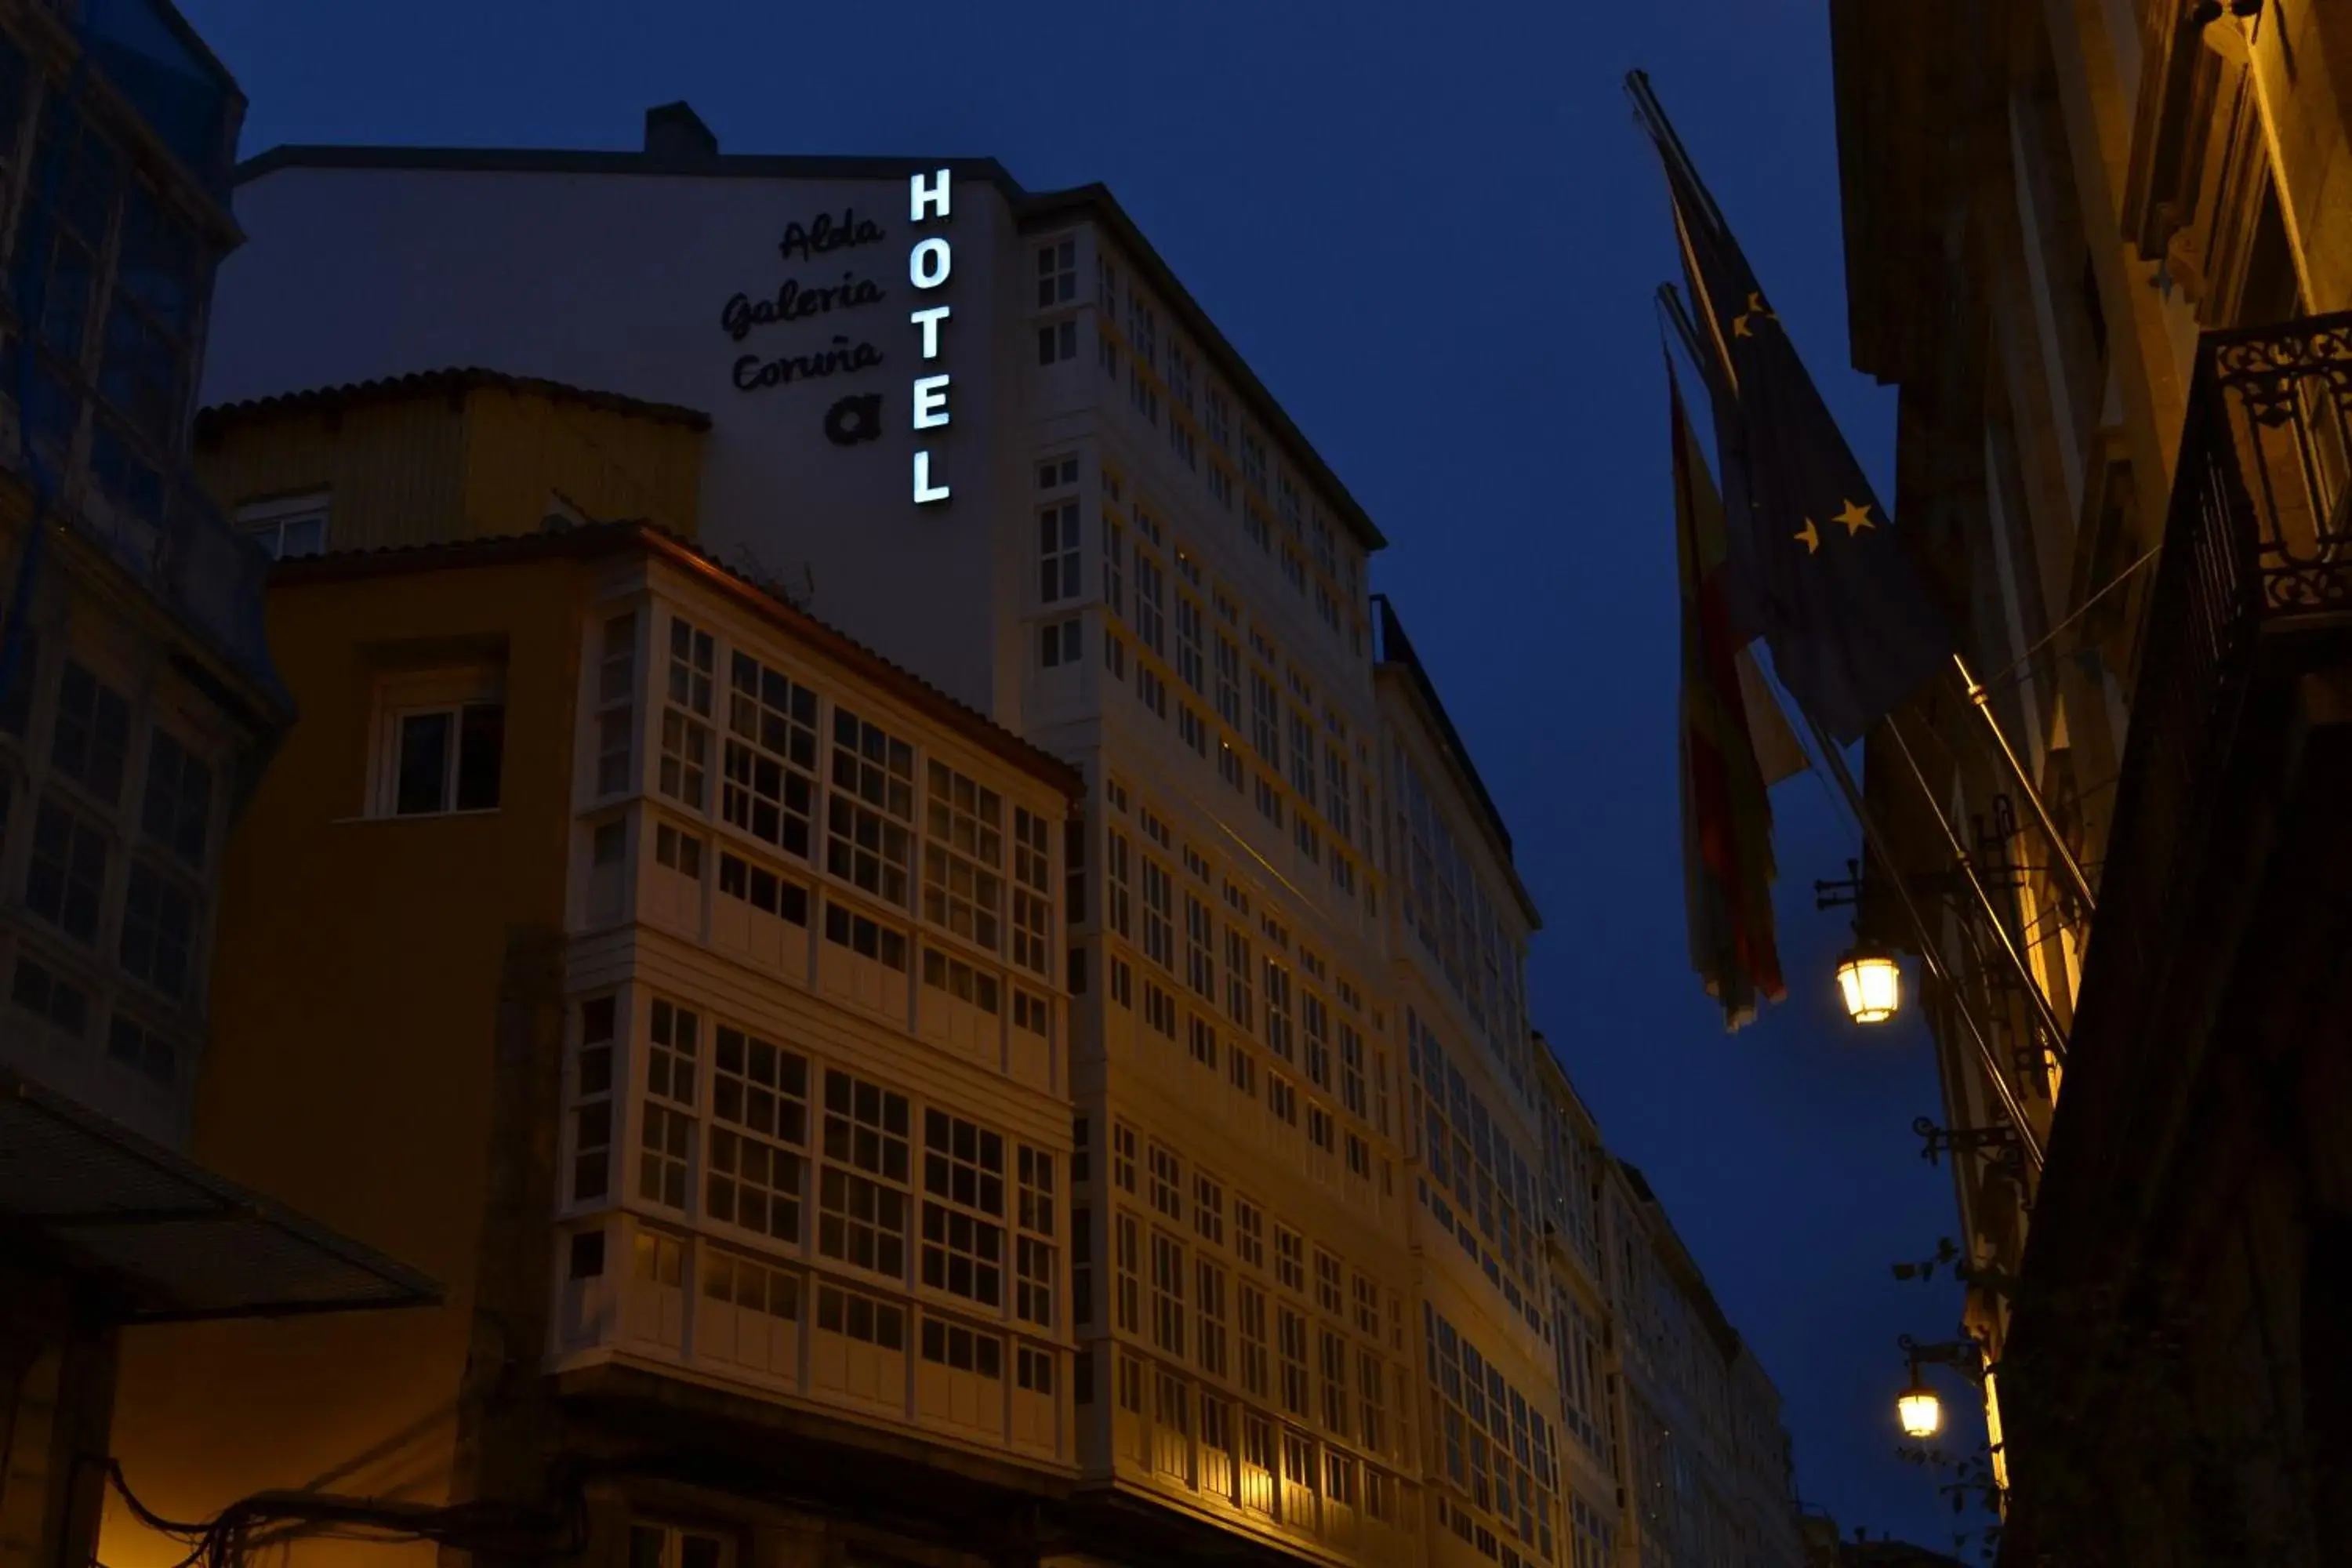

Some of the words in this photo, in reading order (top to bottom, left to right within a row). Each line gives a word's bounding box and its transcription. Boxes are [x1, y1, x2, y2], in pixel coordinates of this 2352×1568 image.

[779, 208, 885, 260] Alda
[734, 336, 884, 390] Coruña
[909, 168, 952, 504] HOTEL
